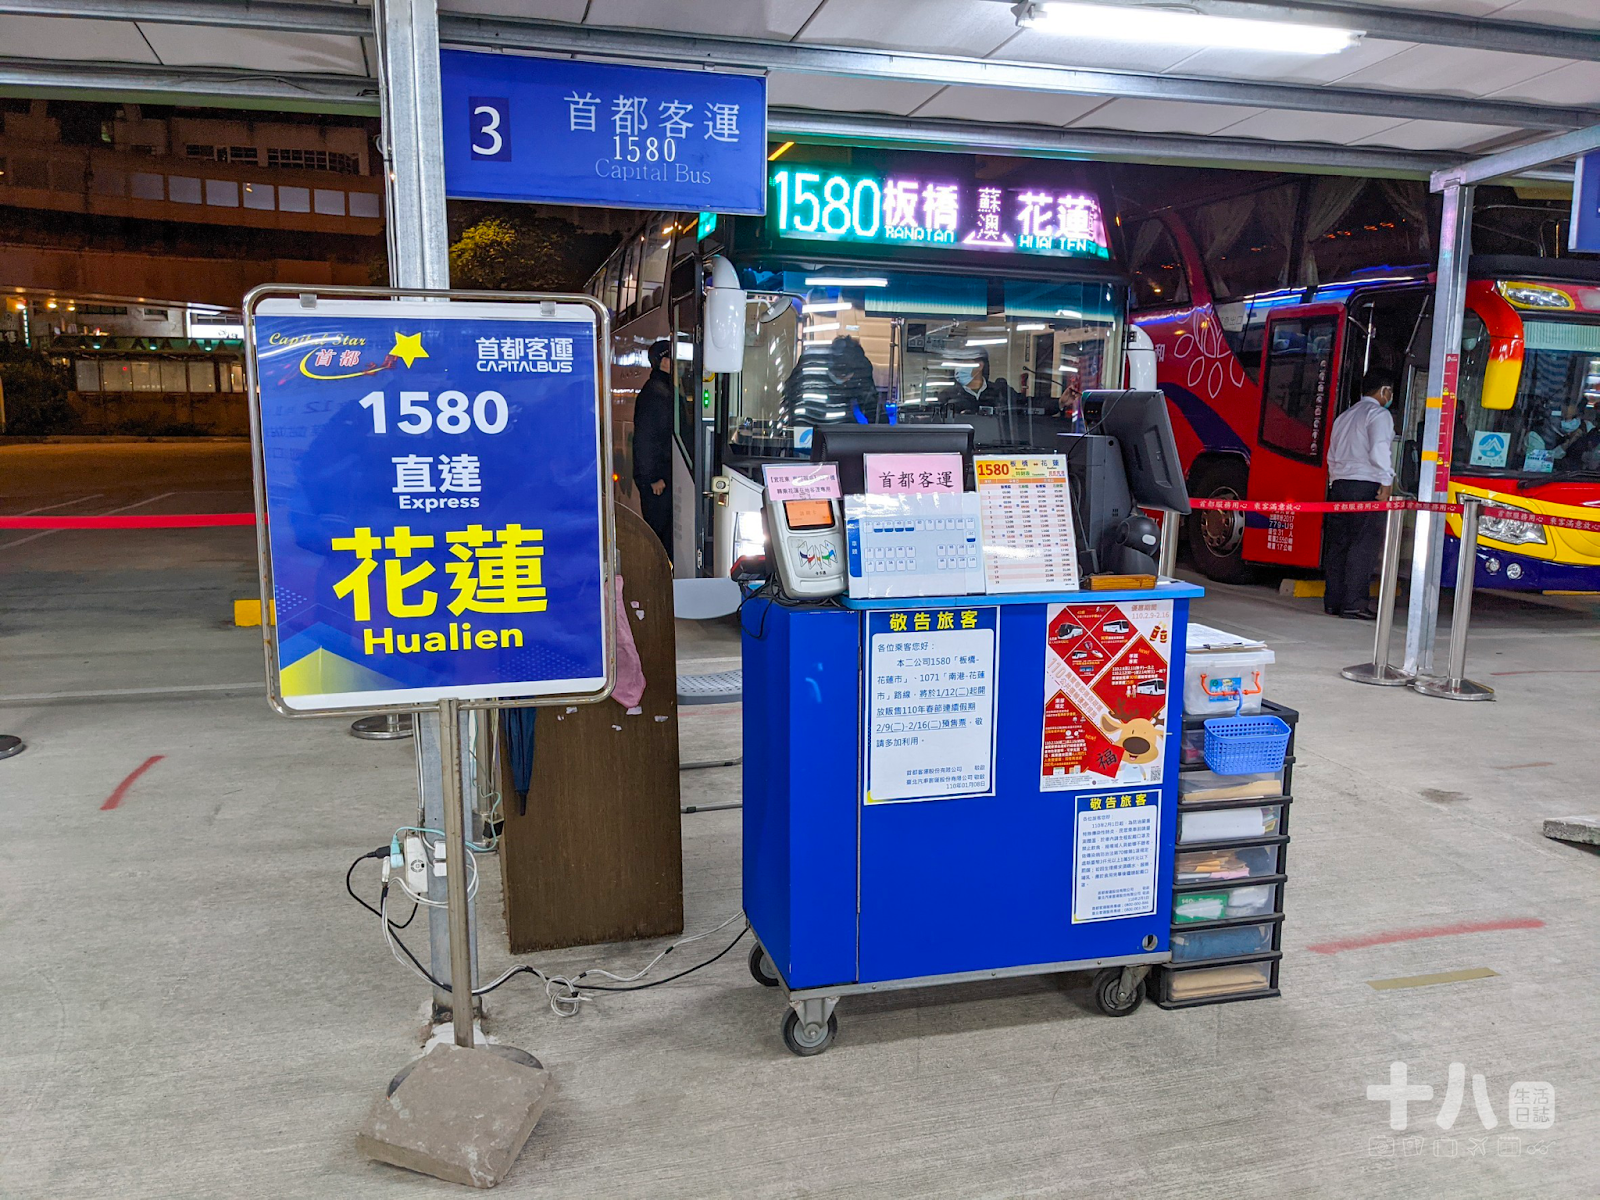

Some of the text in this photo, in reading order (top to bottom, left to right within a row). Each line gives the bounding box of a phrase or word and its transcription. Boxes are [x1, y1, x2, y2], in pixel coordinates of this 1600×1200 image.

[564, 91, 740, 143] 首都客運
[472, 105, 503, 156] 3
[613, 135, 677, 163] 1580
[595, 159, 712, 186] Capital Bus
[774, 170, 882, 238] 1580
[882, 179, 959, 231] 板橋
[978, 186, 1002, 238] 蘇澳
[1017, 191, 1093, 240] 花蓮
[268, 332, 367, 347] Capital Star
[475, 336, 574, 361] 首都客運
[315, 349, 361, 367] 首都
[359, 390, 509, 435] 1580
[391, 453, 483, 495] 直達
[878, 470, 956, 490] 首都客運
[978, 463, 1009, 476] 1580
[399, 495, 480, 513] Express
[1199, 500, 1301, 510] 首都服務用心 乘客滿意放心
[1333, 503, 1380, 511] 首都服務用心
[1406, 501, 1457, 511] 首都服務用心
[1269, 521, 1294, 530] 779-U9
[1497, 510, 1600, 530] 首都服務用心 乘客滿意放心
[331, 523, 548, 621] 花蓮
[889, 610, 979, 632] 敬告旅客
[363, 622, 524, 655] Hualien
[1097, 748, 1118, 769] 福
[1090, 794, 1147, 810] 敬告旅客
